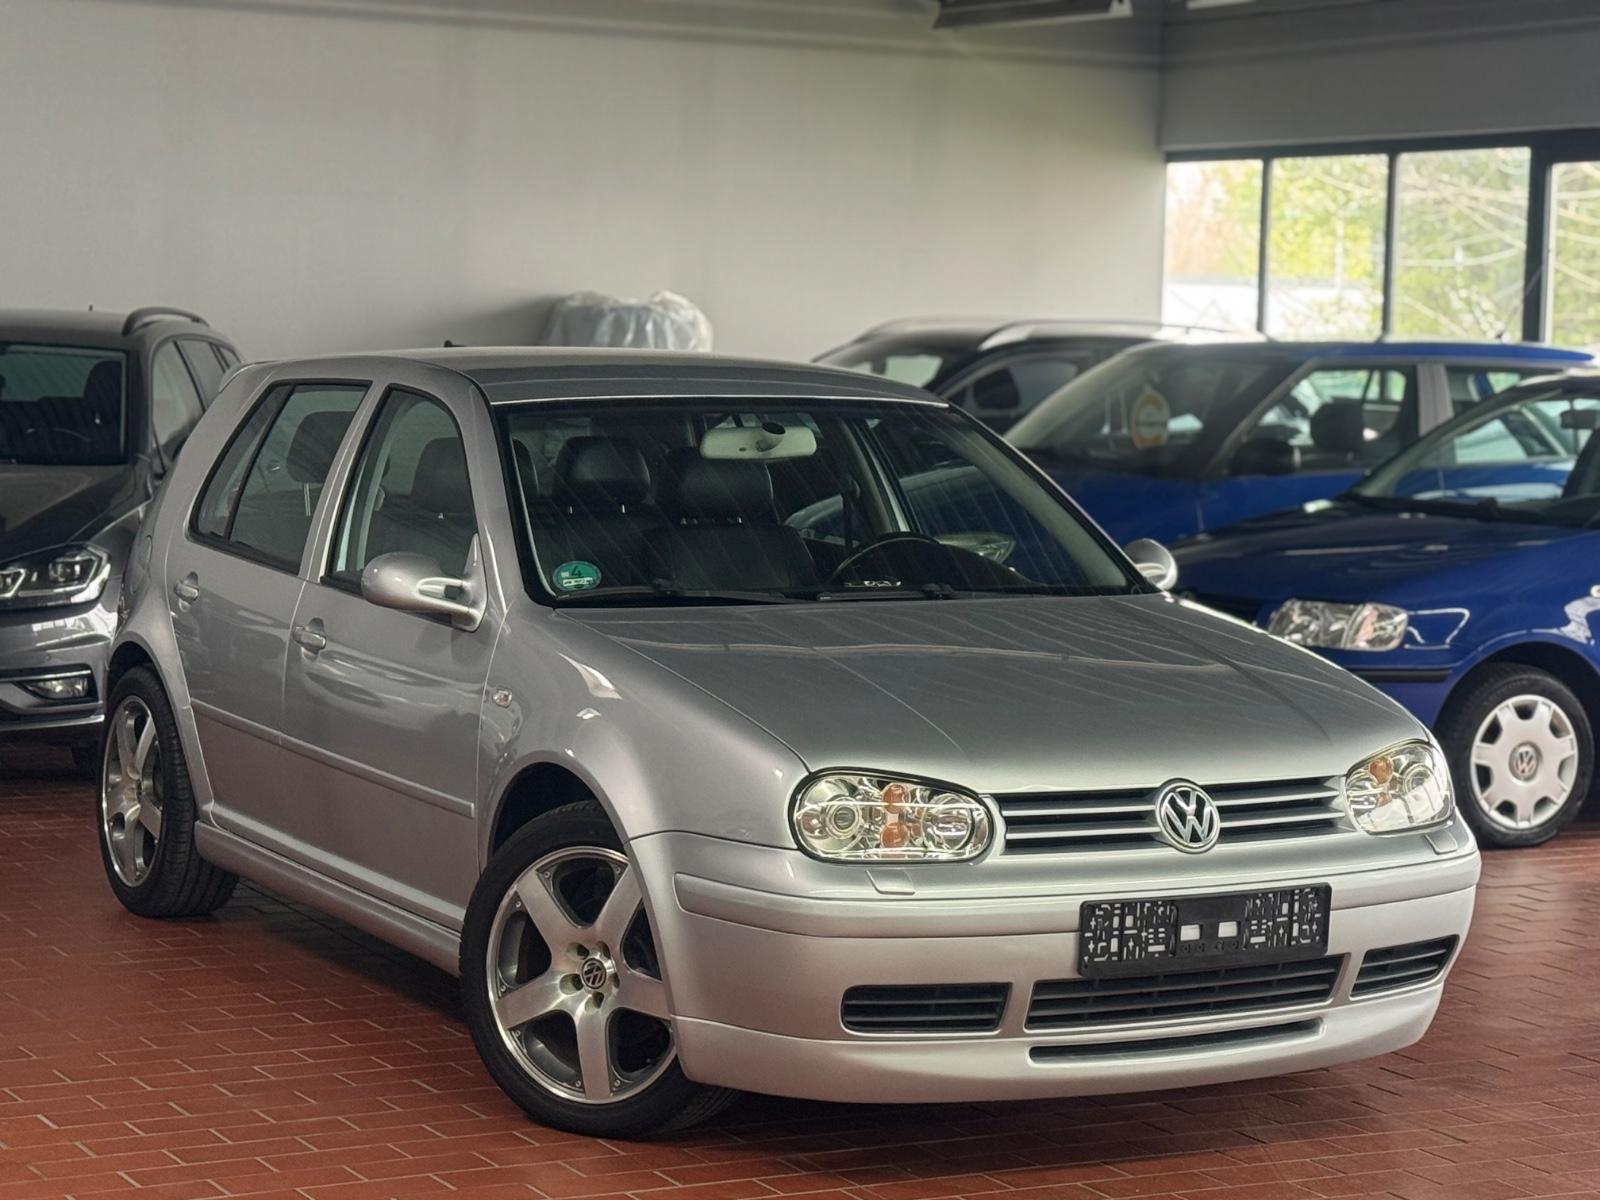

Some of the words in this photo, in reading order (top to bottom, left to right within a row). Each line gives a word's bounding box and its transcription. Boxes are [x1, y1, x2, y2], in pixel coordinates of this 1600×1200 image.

[571, 565, 583, 577] 4
[1512, 747, 1538, 778] VW
[1160, 784, 1219, 847] VW
[582, 961, 606, 987] VW
